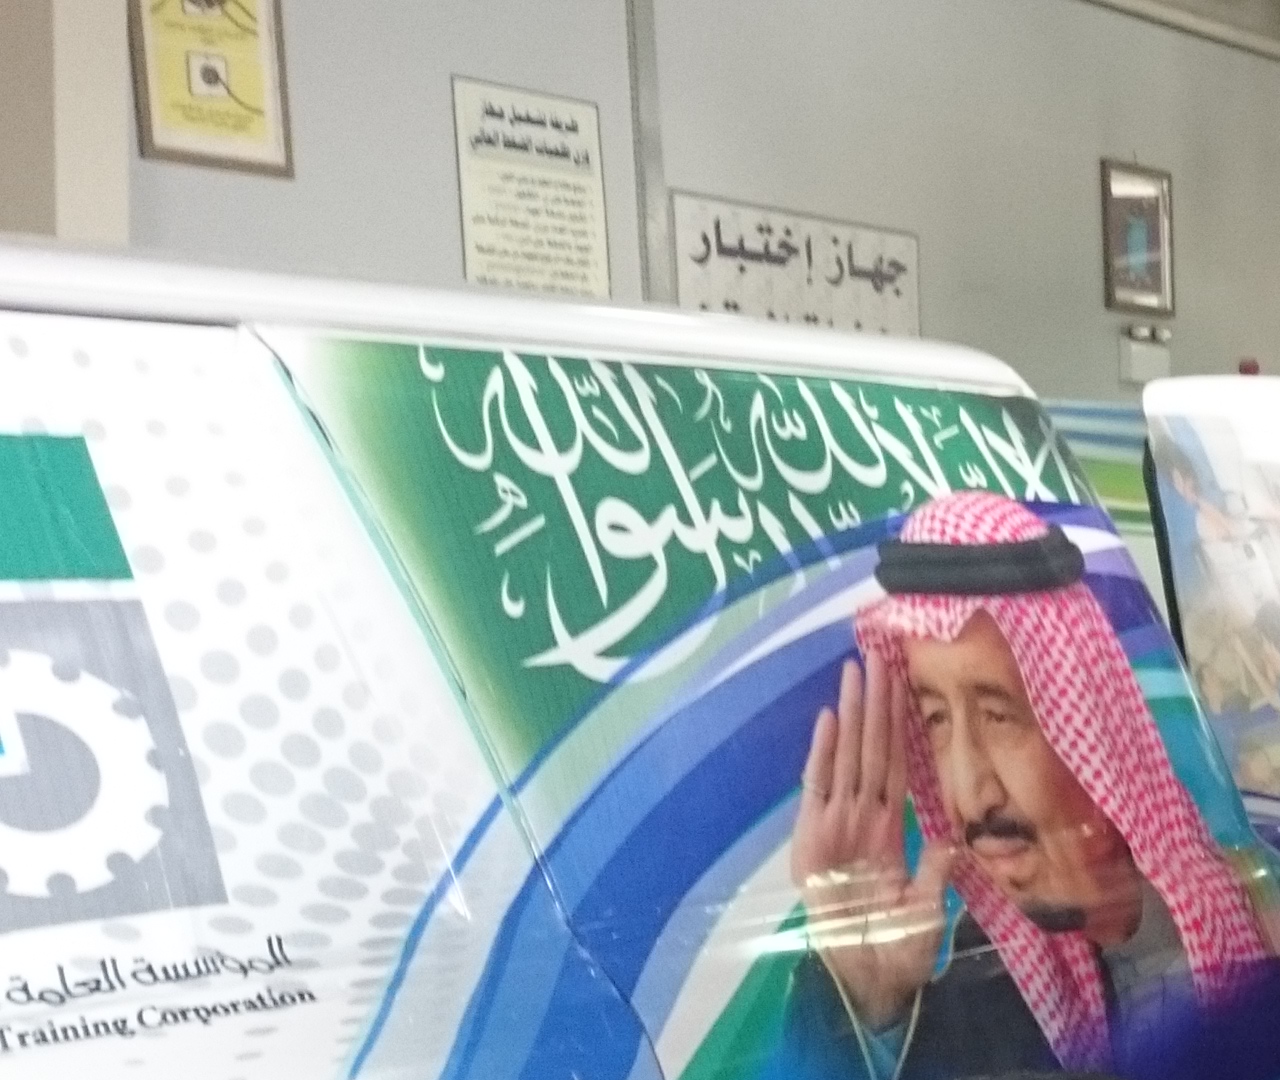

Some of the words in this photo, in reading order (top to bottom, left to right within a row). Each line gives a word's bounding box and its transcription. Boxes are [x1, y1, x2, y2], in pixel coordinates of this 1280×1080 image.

[687, 214, 814, 288] إختبار
[825, 234, 908, 299] جهاز
[4, 956, 127, 1006] العامة
[130, 933, 294, 987] المؤسسة
[0, 1014, 137, 1053] Training
[136, 986, 319, 1030] Corporation
